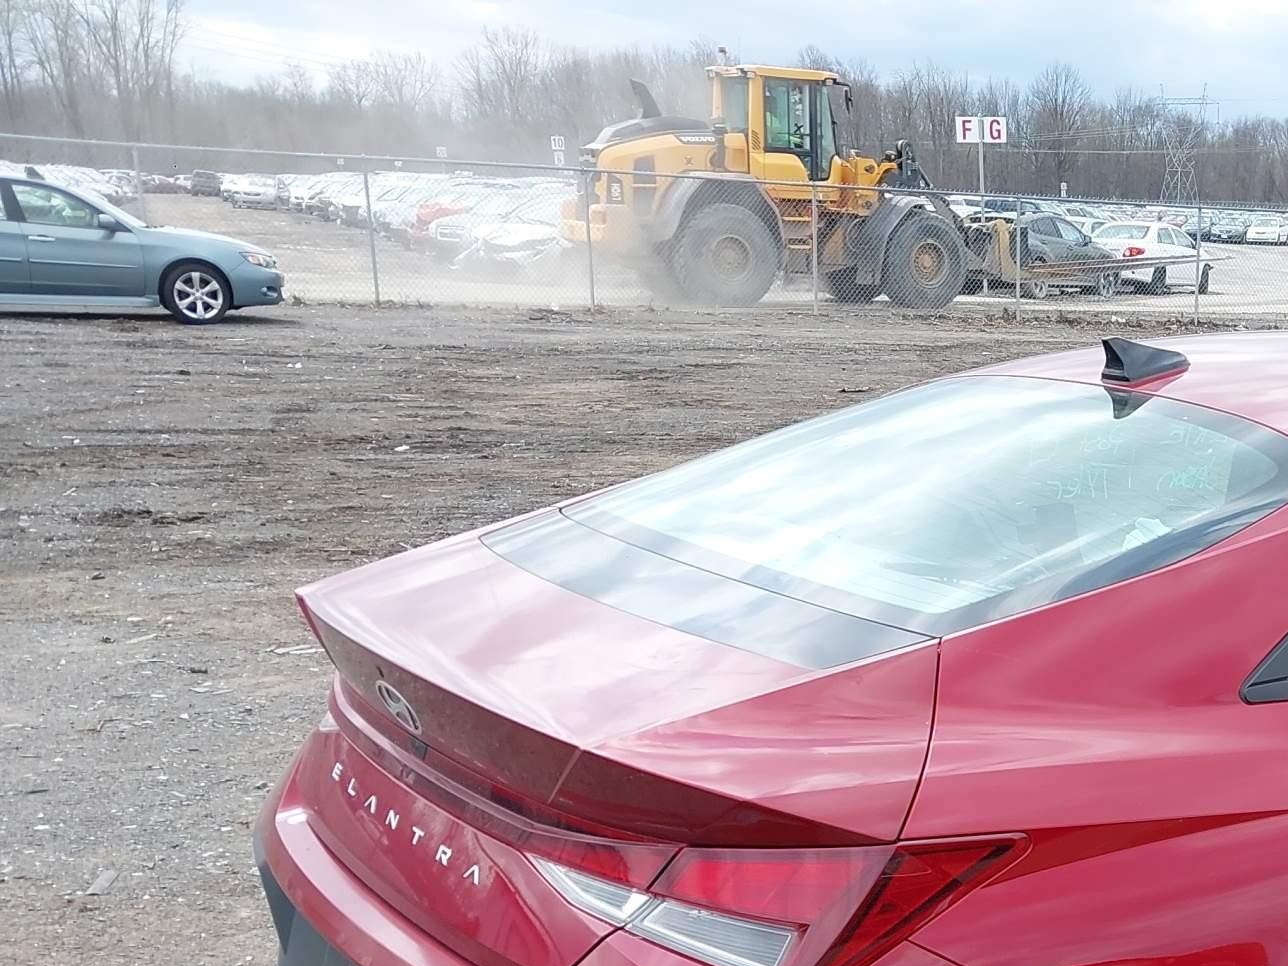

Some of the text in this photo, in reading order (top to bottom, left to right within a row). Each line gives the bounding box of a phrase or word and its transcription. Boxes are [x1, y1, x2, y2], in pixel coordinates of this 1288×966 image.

[961, 119, 1001, 141] F G
[331, 762, 480, 886] ELANTRA
